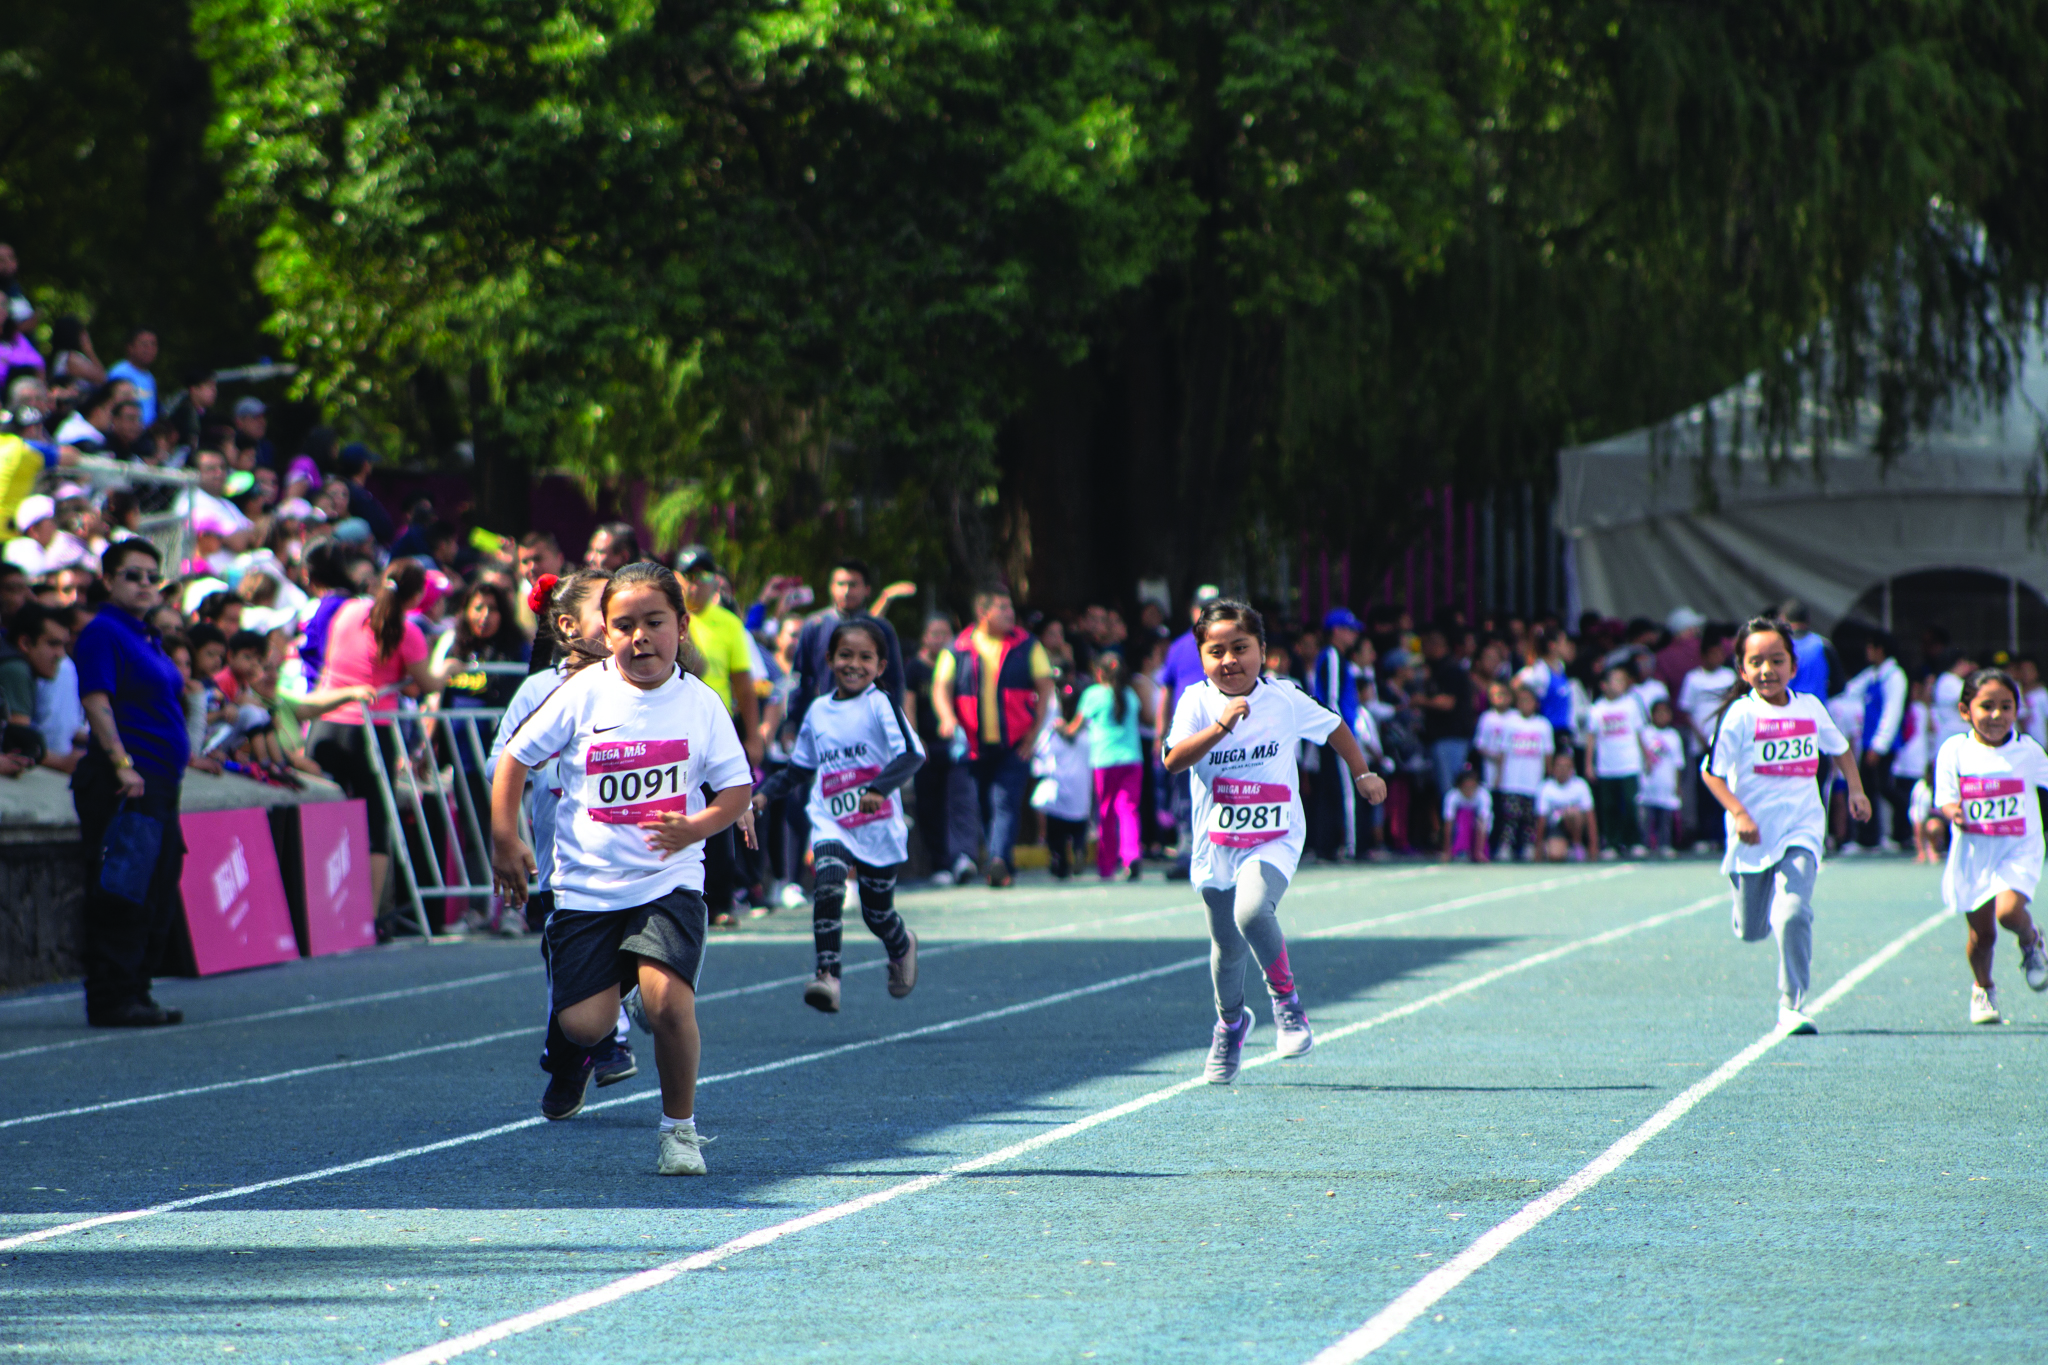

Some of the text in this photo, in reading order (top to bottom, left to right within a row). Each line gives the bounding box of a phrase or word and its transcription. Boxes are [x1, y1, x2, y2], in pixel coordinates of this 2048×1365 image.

[591, 743, 647, 762] JUEGA MÁS
[1209, 741, 1279, 765] JUEGA MÁS
[1762, 737, 1813, 761] 0236
[599, 765, 678, 803] 0091
[1217, 783, 1261, 794] JUEGA MÁS
[1218, 805, 1281, 830] 0981
[1969, 796, 2018, 820] 0212
